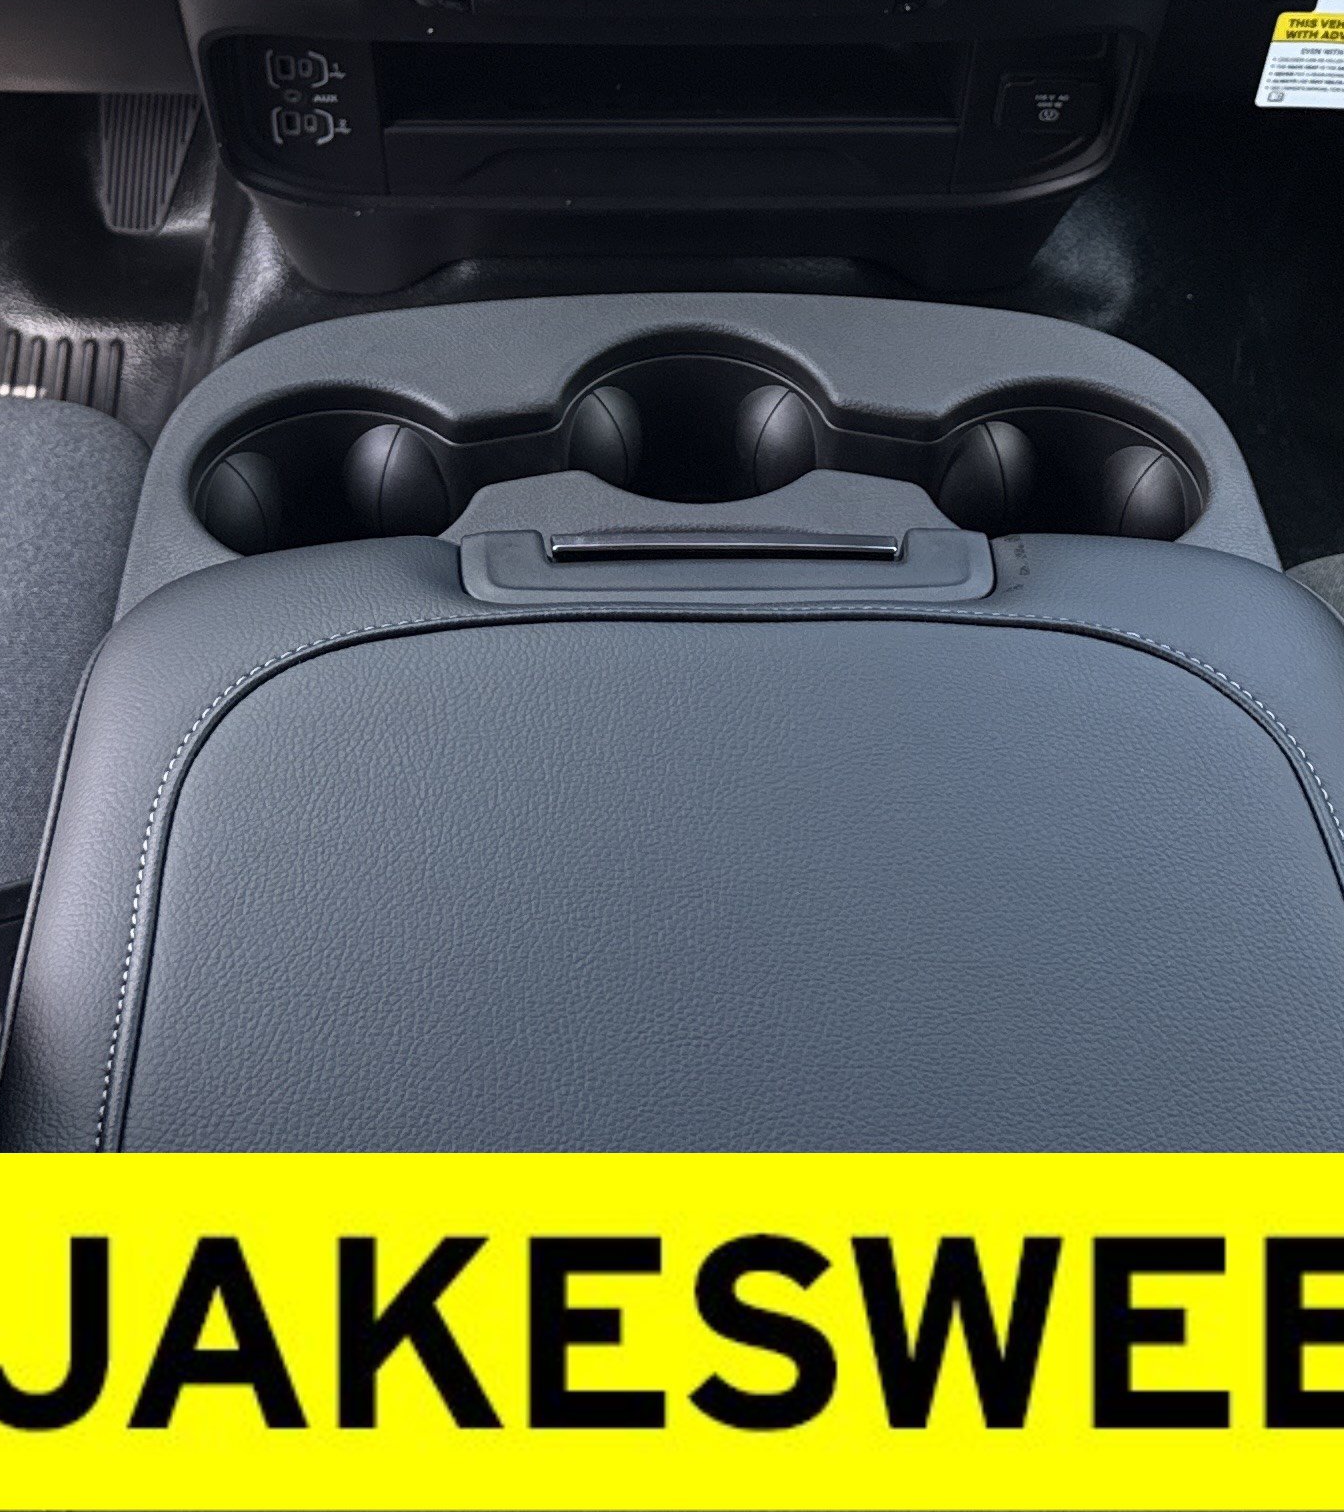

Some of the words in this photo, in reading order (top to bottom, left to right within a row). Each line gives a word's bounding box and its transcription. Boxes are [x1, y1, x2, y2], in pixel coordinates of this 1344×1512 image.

[1288, 18, 1318, 29] THIS
[1285, 29, 1318, 40] WITH
[312, 93, 338, 104] AUX
